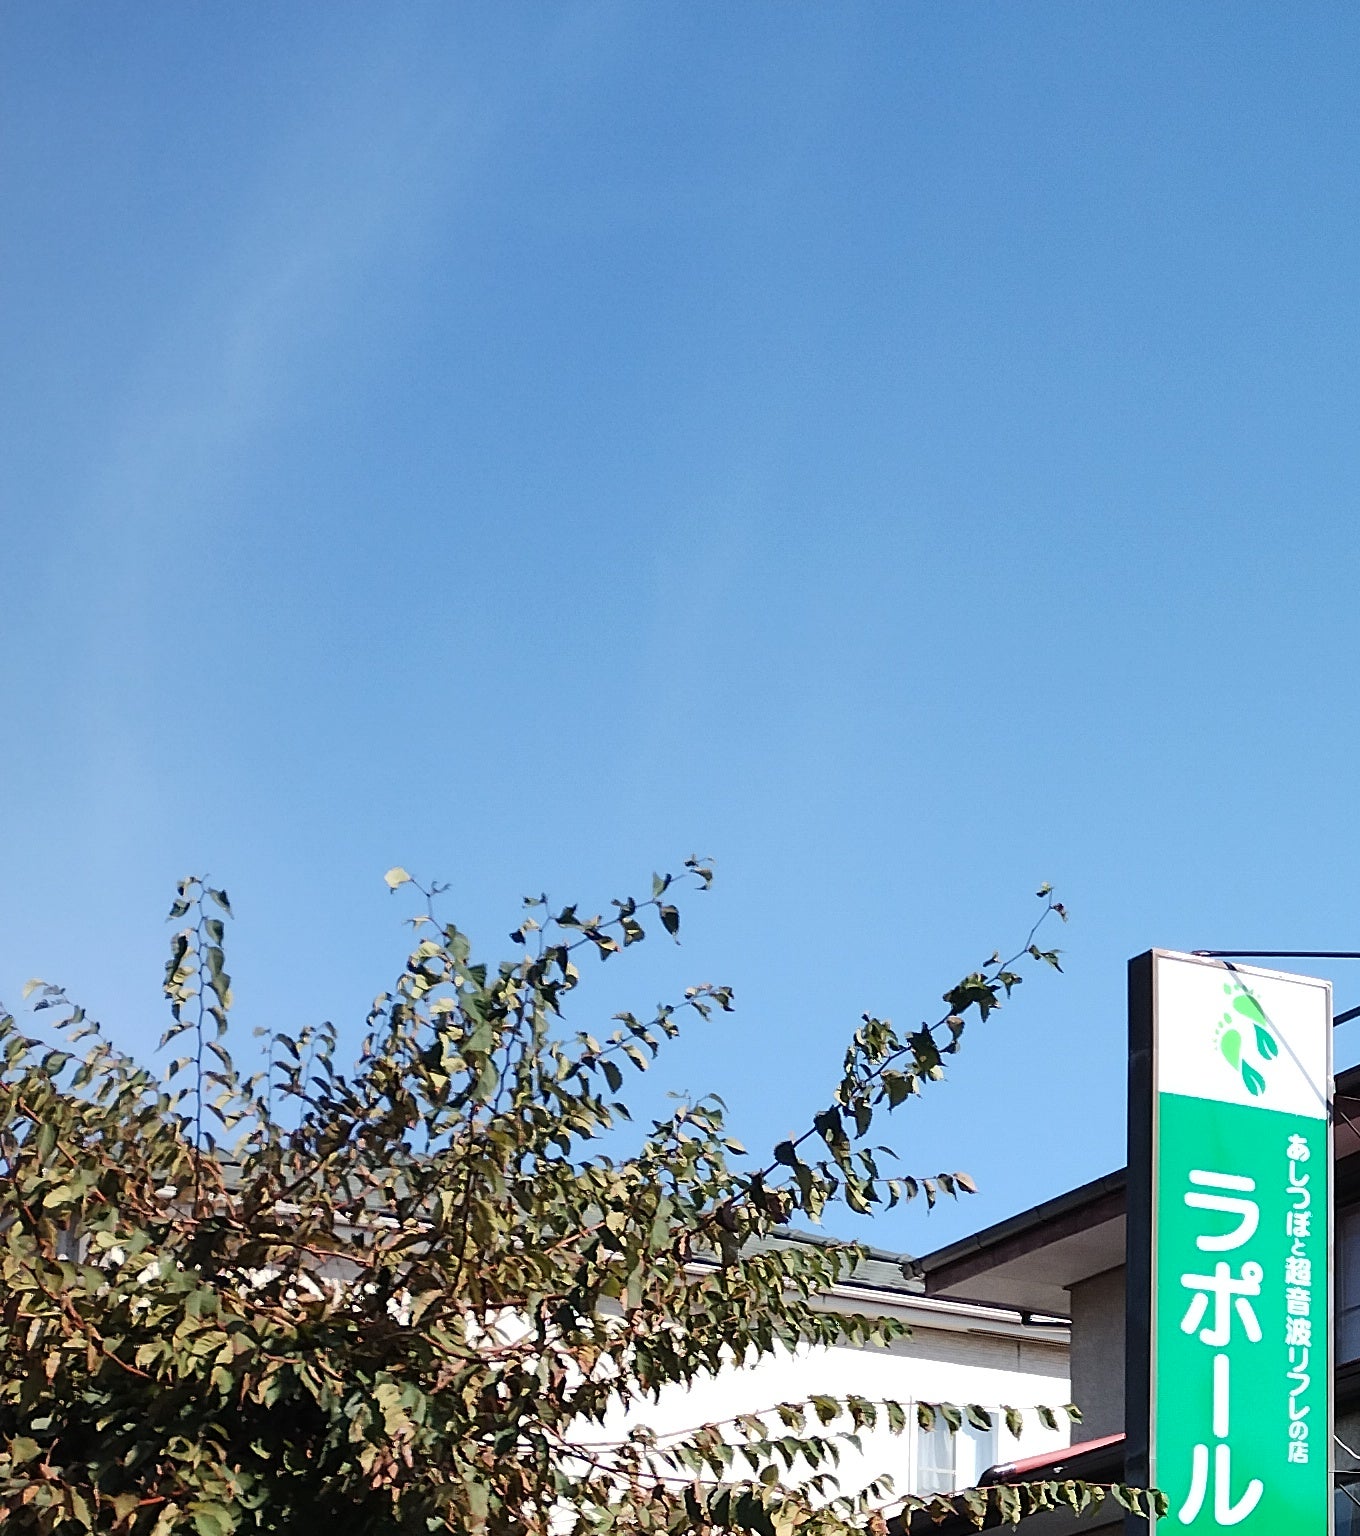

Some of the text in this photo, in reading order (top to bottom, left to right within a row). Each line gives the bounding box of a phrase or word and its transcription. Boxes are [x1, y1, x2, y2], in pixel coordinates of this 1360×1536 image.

[1178, 1168, 1264, 1527] ラポール
[1284, 1133, 1312, 1464] あしつぼと超音波リフレの店
